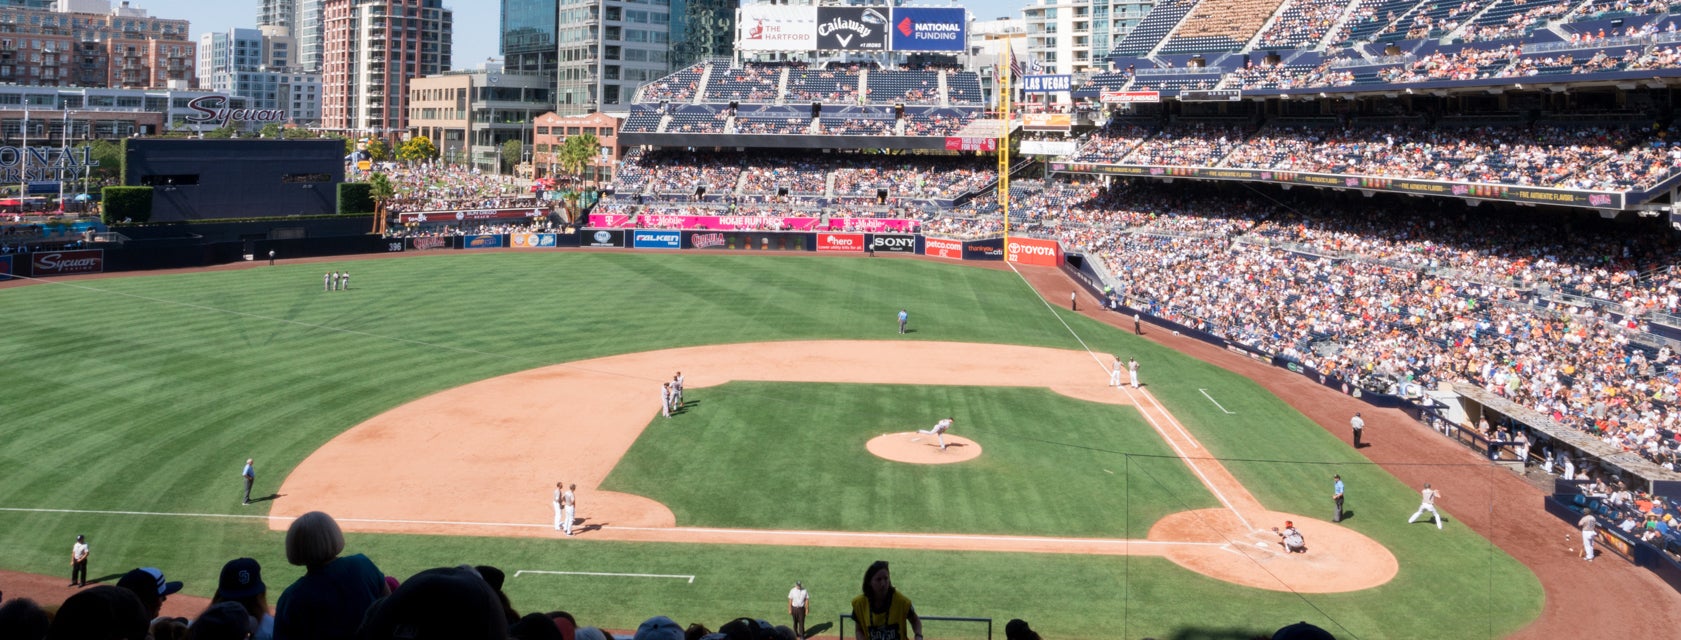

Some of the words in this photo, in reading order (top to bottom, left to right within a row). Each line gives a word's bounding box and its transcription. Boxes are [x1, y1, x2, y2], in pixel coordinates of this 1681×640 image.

[818, 17, 872, 38] Callaway
[915, 23, 960, 32] NATIONAL
[915, 32, 957, 40] FUNDING
[1025, 77, 1040, 90] LAS
[1042, 76, 1070, 90] VEGAS
[186, 95, 288, 128] Sycuan
[720, 216, 743, 225] HOME
[744, 216, 762, 226] RUN
[691, 233, 726, 248] CHOLULA
[834, 236, 852, 245] hero
[875, 238, 914, 247] SONY
[926, 240, 961, 250] petco.com
[388, 243, 401, 251] 396
[1021, 245, 1055, 256] TOYOTA
[36, 254, 97, 271] Sycuan
